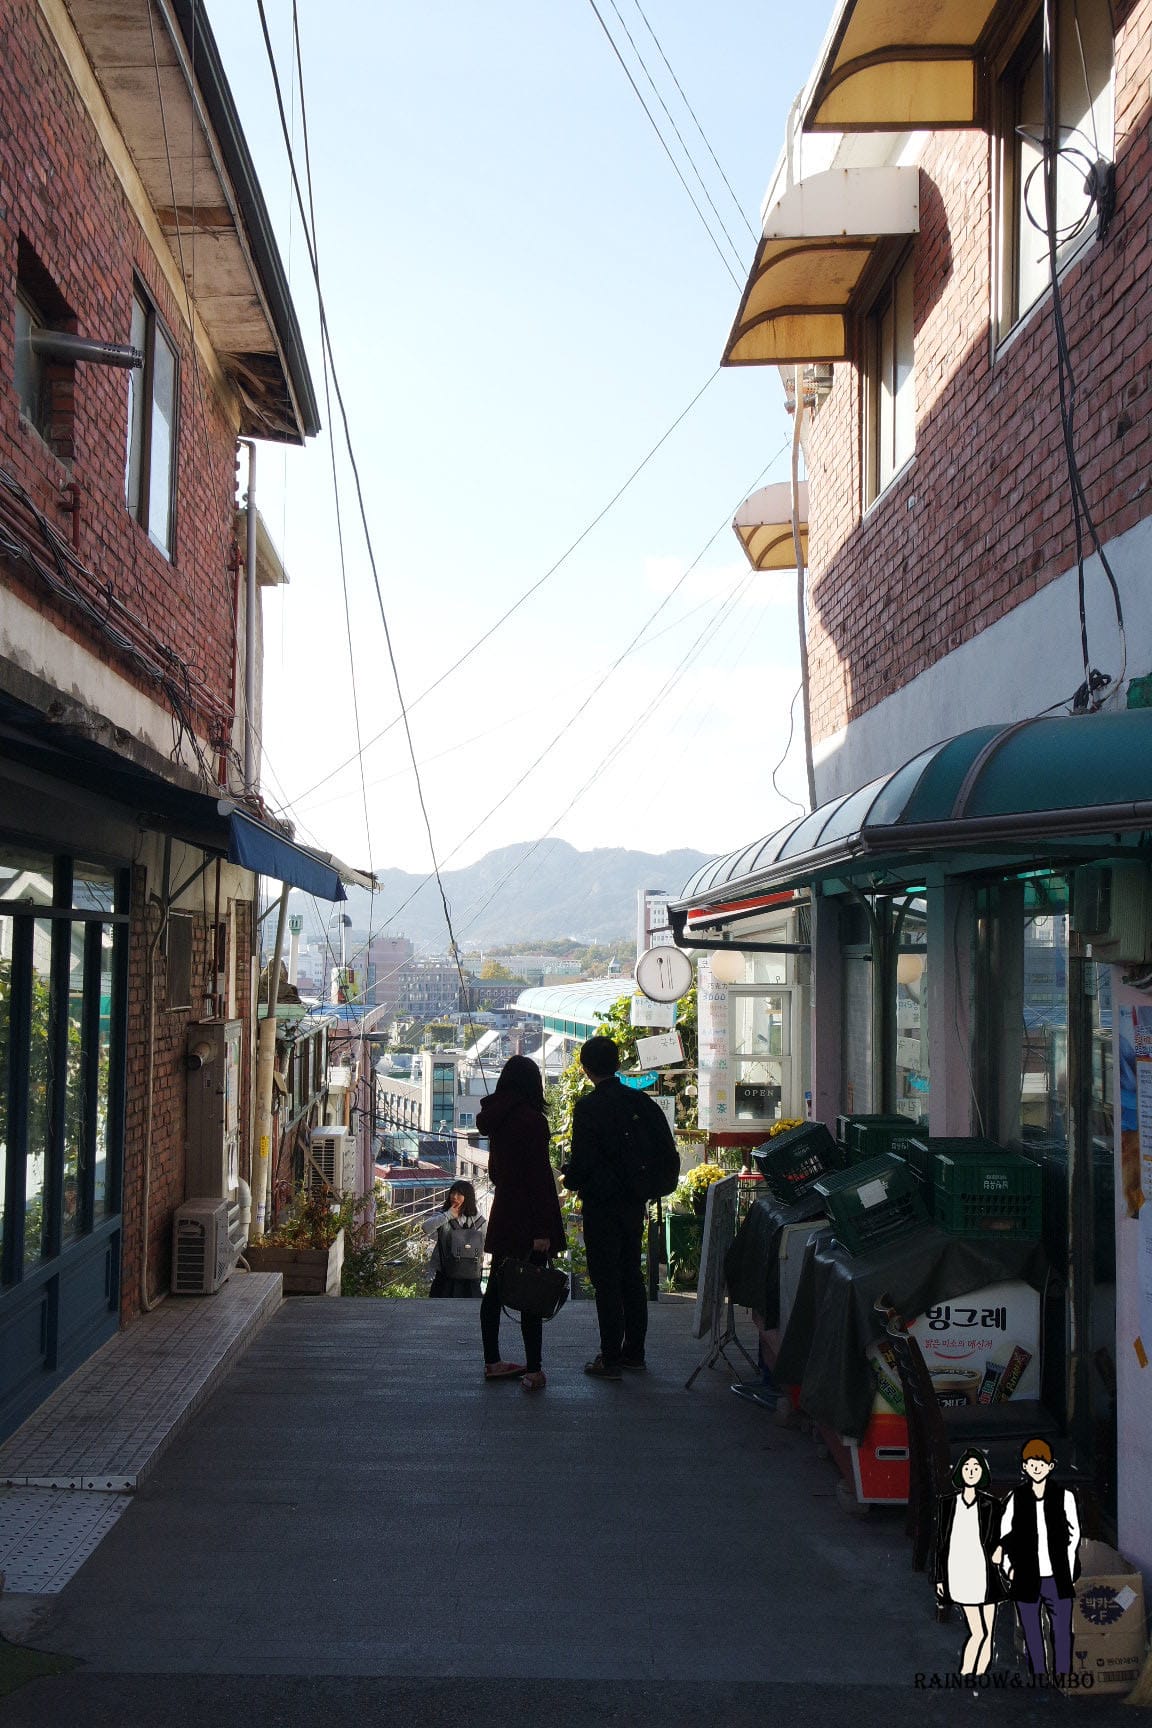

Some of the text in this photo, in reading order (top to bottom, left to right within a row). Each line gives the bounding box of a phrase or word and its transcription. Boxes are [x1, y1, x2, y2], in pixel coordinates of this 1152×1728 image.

[744, 1089, 774, 1097] OPEN
[926, 1306, 1006, 1331] 빙그레
[942, 1339, 964, 1348] 미소의
[1100, 1610, 1108, 1621] F
